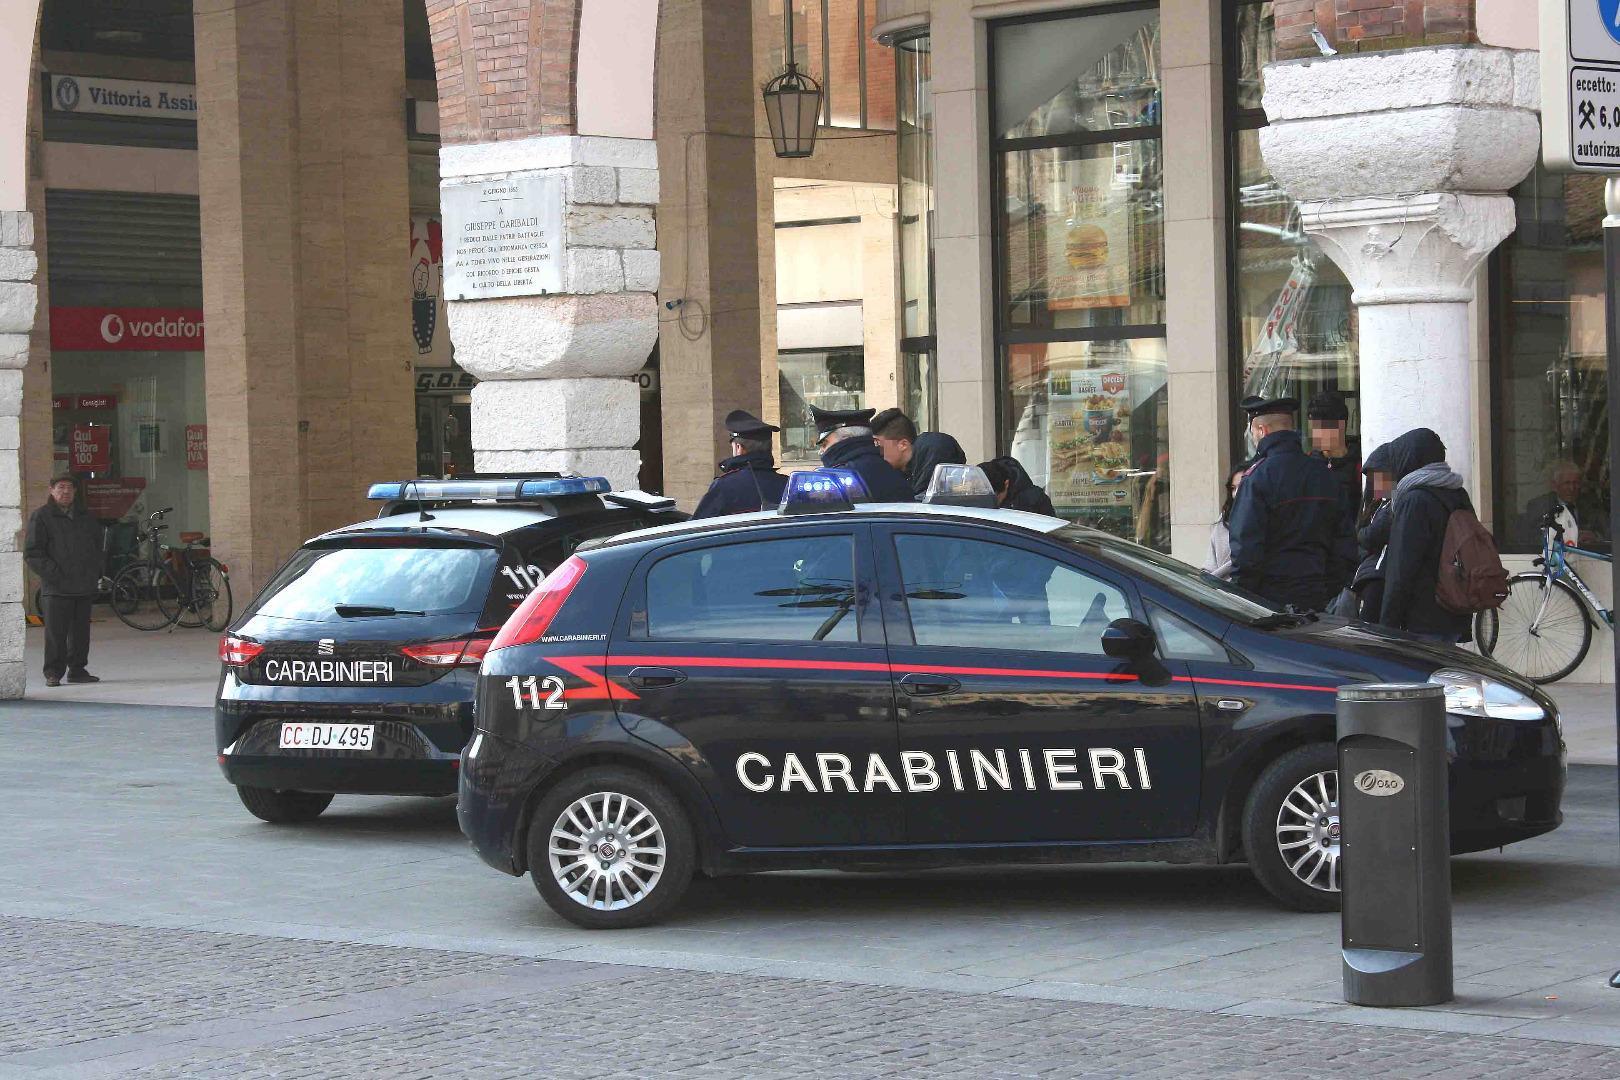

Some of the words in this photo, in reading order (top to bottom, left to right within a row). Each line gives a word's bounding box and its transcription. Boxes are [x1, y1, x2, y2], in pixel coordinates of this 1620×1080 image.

[1576, 77, 1616, 93] eccetto:
[88, 87, 152, 108] Vittoria
[1577, 140, 1620, 157] autorizza
[498, 206, 503, 215] A
[464, 221, 496, 232] GIUSEPPE
[500, 217, 538, 228] GARIBALDI
[74, 430, 92, 441] Qui
[186, 429, 203, 440] Qui
[74, 441, 98, 452] Fibra
[76, 453, 93, 464] 100
[187, 452, 203, 462] IVA
[501, 564, 546, 590] 112
[541, 634, 607, 643] WWW.CARABINIERI.IT
[265, 660, 393, 682] CARABINIERI
[505, 675, 568, 710] 112
[283, 727, 303, 745] CC
[312, 727, 333, 746] DJ
[338, 727, 371, 747] 495
[735, 747, 1152, 793] CARABINIERI
